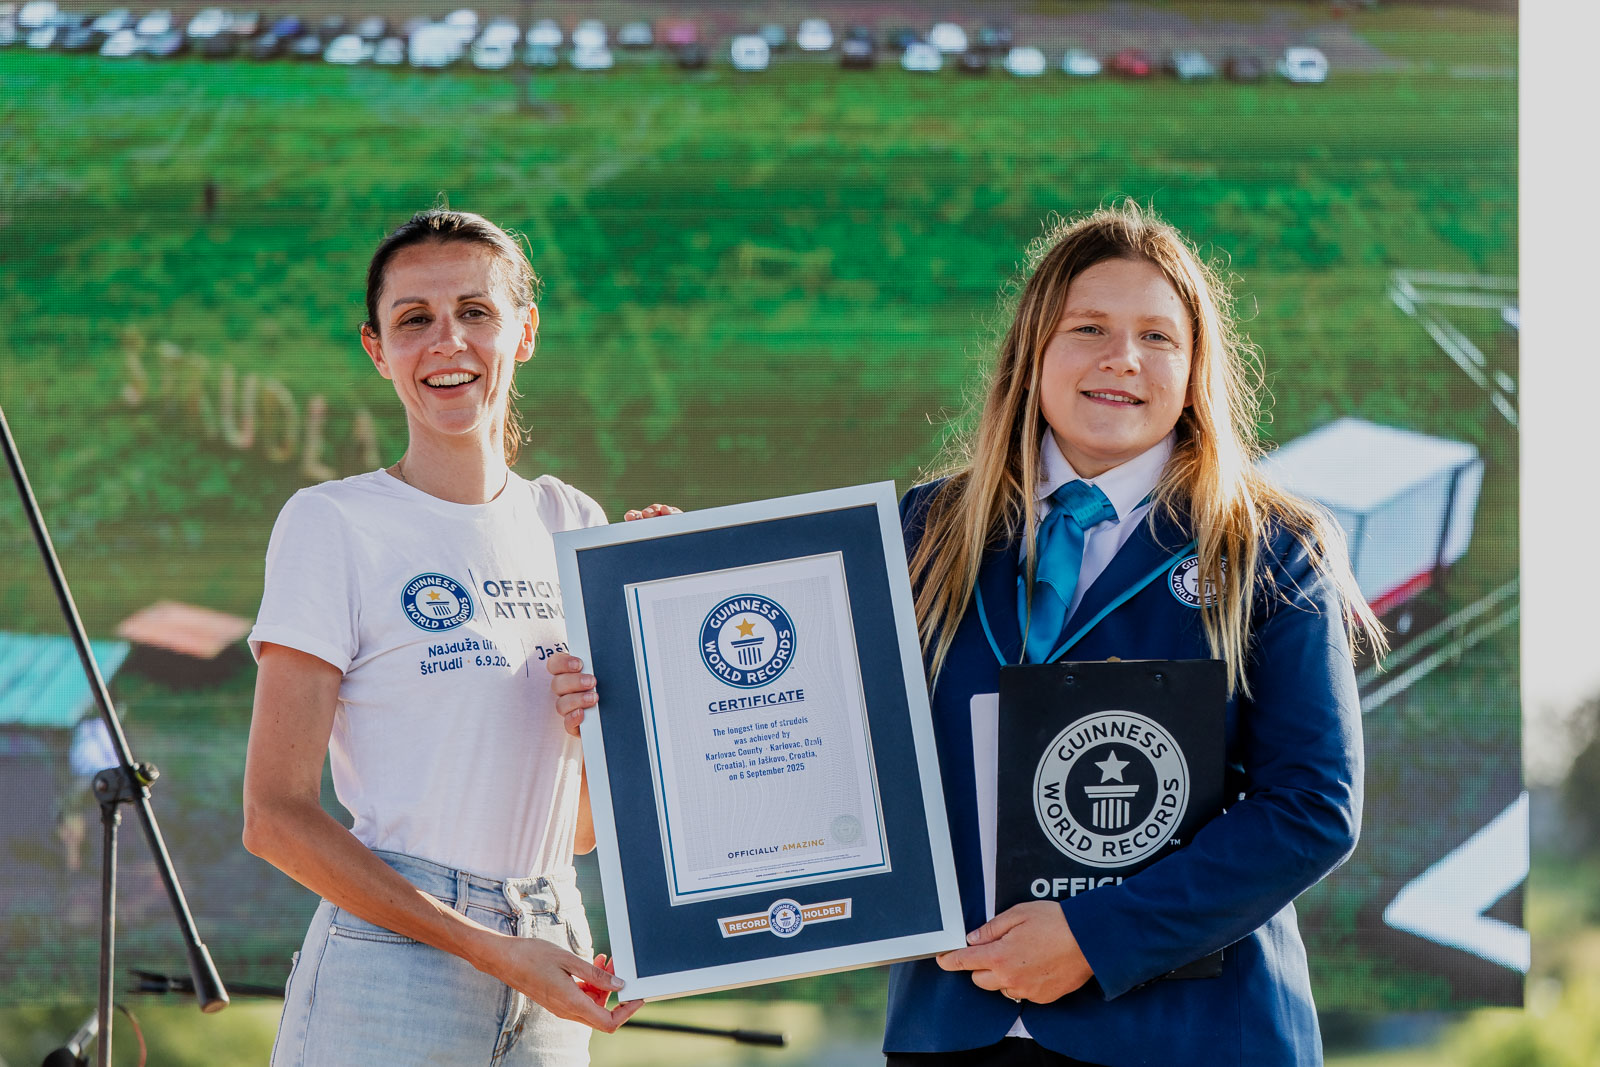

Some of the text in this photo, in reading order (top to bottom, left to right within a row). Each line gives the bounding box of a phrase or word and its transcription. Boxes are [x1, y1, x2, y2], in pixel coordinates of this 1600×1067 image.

[407, 577, 458, 596] GUINNESS
[1173, 574, 1194, 602] WORLD
[406, 597, 470, 628] WORLD RECORDS
[494, 601, 565, 619] ATTEM
[710, 599, 780, 629] GUINNESS
[428, 638, 480, 658] Najduža
[705, 629, 791, 684] WORLD RECORDS
[420, 655, 511, 675] štrudli 6.9.20
[708, 689, 805, 713] CERTIFICATE
[712, 716, 808, 737] The longest line of strudels
[749, 731, 780, 743] achieved
[781, 730, 791, 739] by
[705, 751, 736, 761] Karlovac
[738, 746, 763, 756] County
[804, 737, 822, 747] Ozalj
[1058, 721, 1169, 762] GUINNESS
[749, 759, 756, 767] in
[758, 755, 788, 766] Jaškovo,
[789, 750, 818, 761] Croatia,
[728, 762, 805, 781] on 6 September 2025
[1043, 778, 1180, 857] WORLD RECORDS
[727, 838, 824, 859] OFFICIALLY AMAZING
[728, 906, 842, 932] RECORD HOLDER
